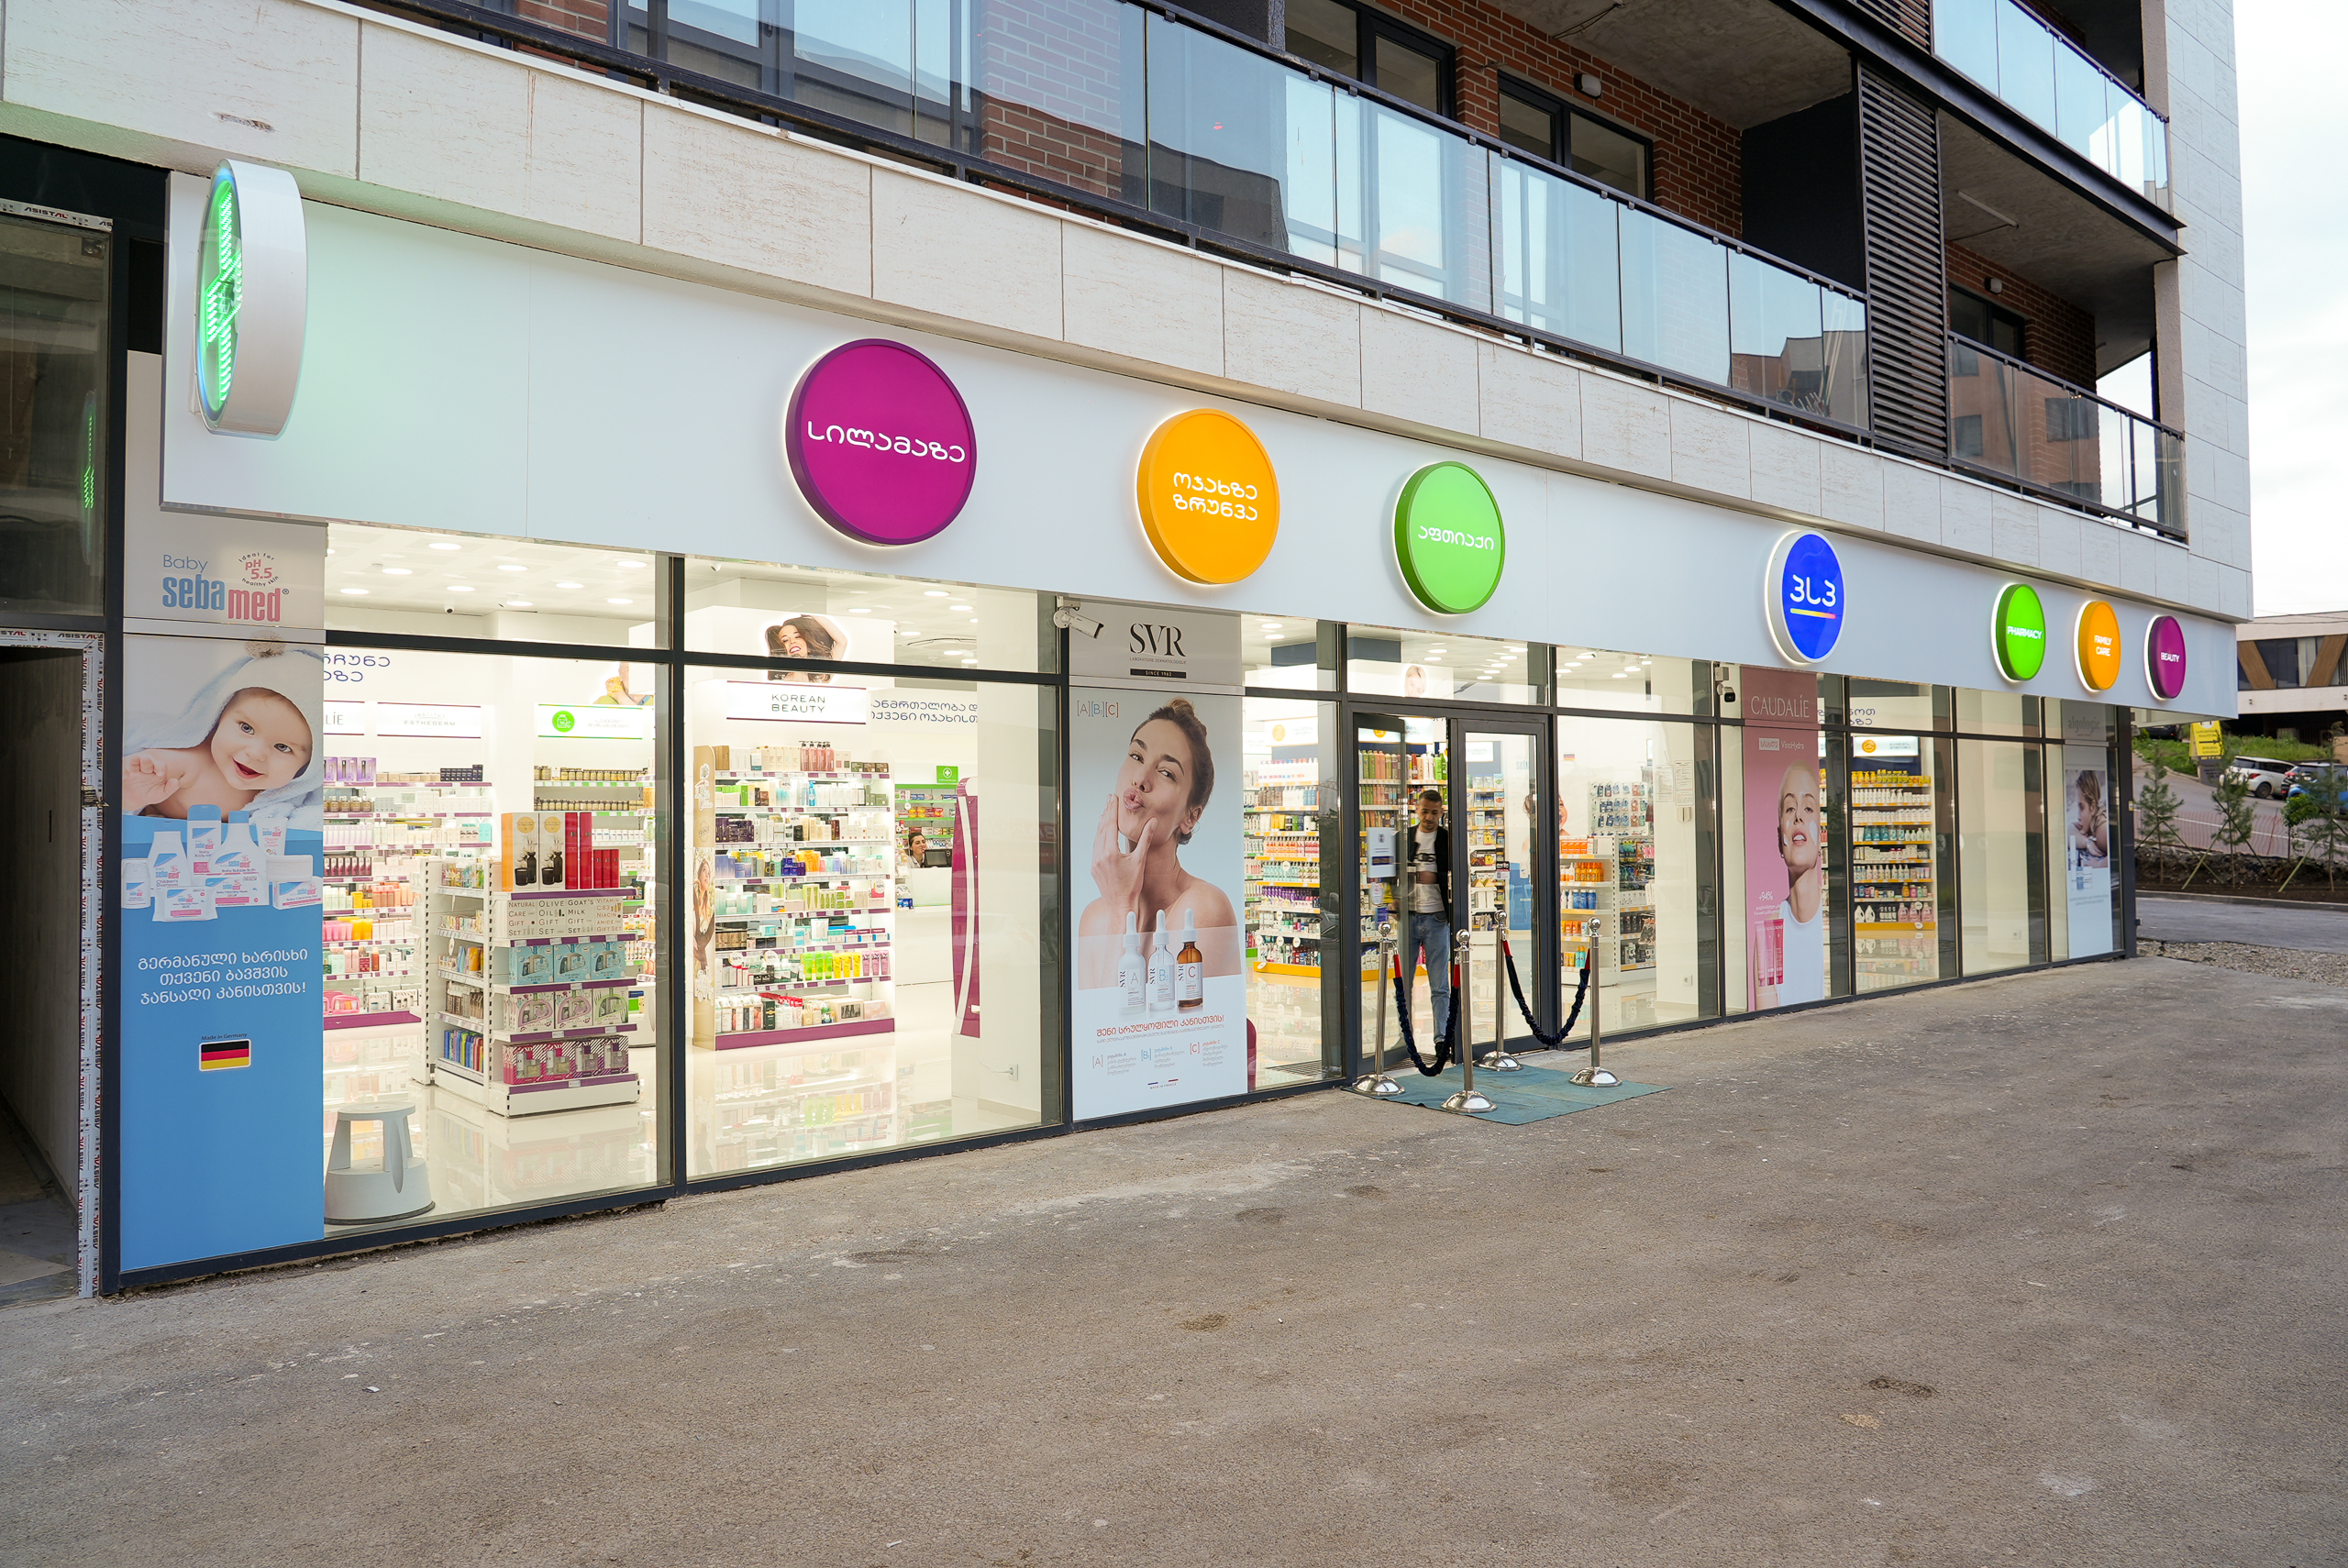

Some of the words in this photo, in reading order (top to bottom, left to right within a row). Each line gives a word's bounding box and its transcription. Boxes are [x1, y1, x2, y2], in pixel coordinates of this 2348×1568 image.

[24, 206, 69, 219] ASISTAL
[807, 420, 966, 463] სილამაზე
[1173, 471, 1258, 501] ოჯახზე
[1172, 493, 1258, 521] ზრუნვა
[1418, 525, 1495, 551] აფთიაქი
[263, 552, 275, 561] for
[163, 554, 208, 573] Baby
[245, 559, 261, 570] pH
[250, 568, 272, 580] 5.5
[241, 578, 267, 587] healthy
[268, 575, 280, 585] skin
[1789, 574, 1836, 607] პსპ
[2007, 625, 2043, 639] PHARMACY
[1129, 623, 1186, 657] SVR
[2094, 635, 2112, 646] FAMILY
[2096, 646, 2110, 657] CARE
[2161, 652, 2180, 663] BEAUTY
[771, 693, 825, 703] KOREAN
[771, 704, 825, 713] BEAUTY
[871, 700, 966, 712] ანმრთელობა
[1751, 694, 1810, 718] CAUDALÍE
[1780, 740, 1805, 751] VinoHydra
[1758, 891, 1773, 900] +94%
[538, 909, 553, 917] OIL
[138, 953, 238, 971] გერმანული
[241, 949, 308, 964] ხარისხი
[160, 970, 221, 986] თქვენი
[226, 966, 289, 981] ბავშვის
[140, 988, 211, 1005] ჯანსაღი
[216, 981, 306, 999] კანისთვის!
[1096, 1027, 1116, 1037] შენი
[1118, 1019, 1179, 1034] სრულყოფილი
[1180, 1014, 1224, 1027] კანისთვის!
